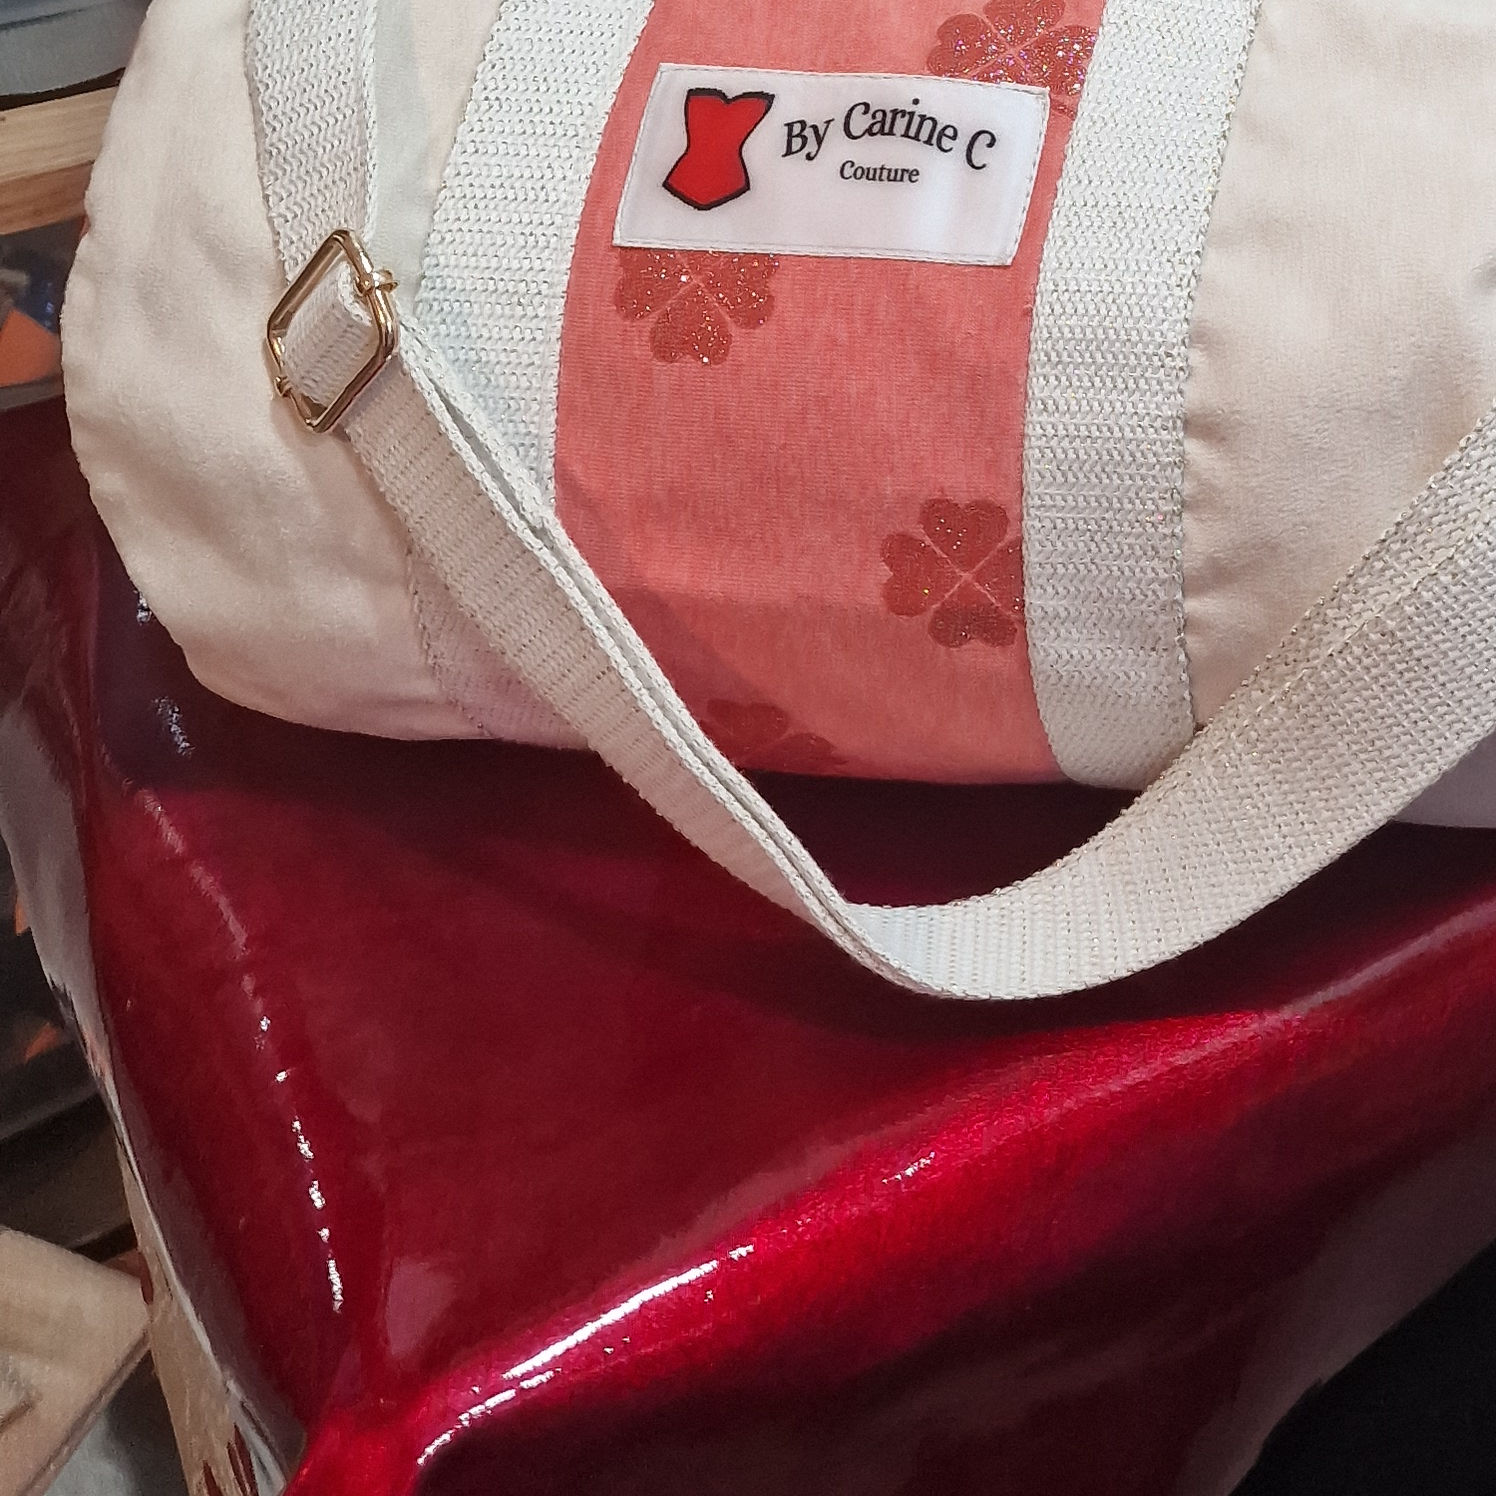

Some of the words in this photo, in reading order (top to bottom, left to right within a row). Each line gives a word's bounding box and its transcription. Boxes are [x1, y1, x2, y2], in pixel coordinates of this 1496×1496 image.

[781, 117, 835, 161] By
[842, 98, 959, 153] Carine
[965, 129, 997, 170] C
[839, 160, 920, 184] Couture
